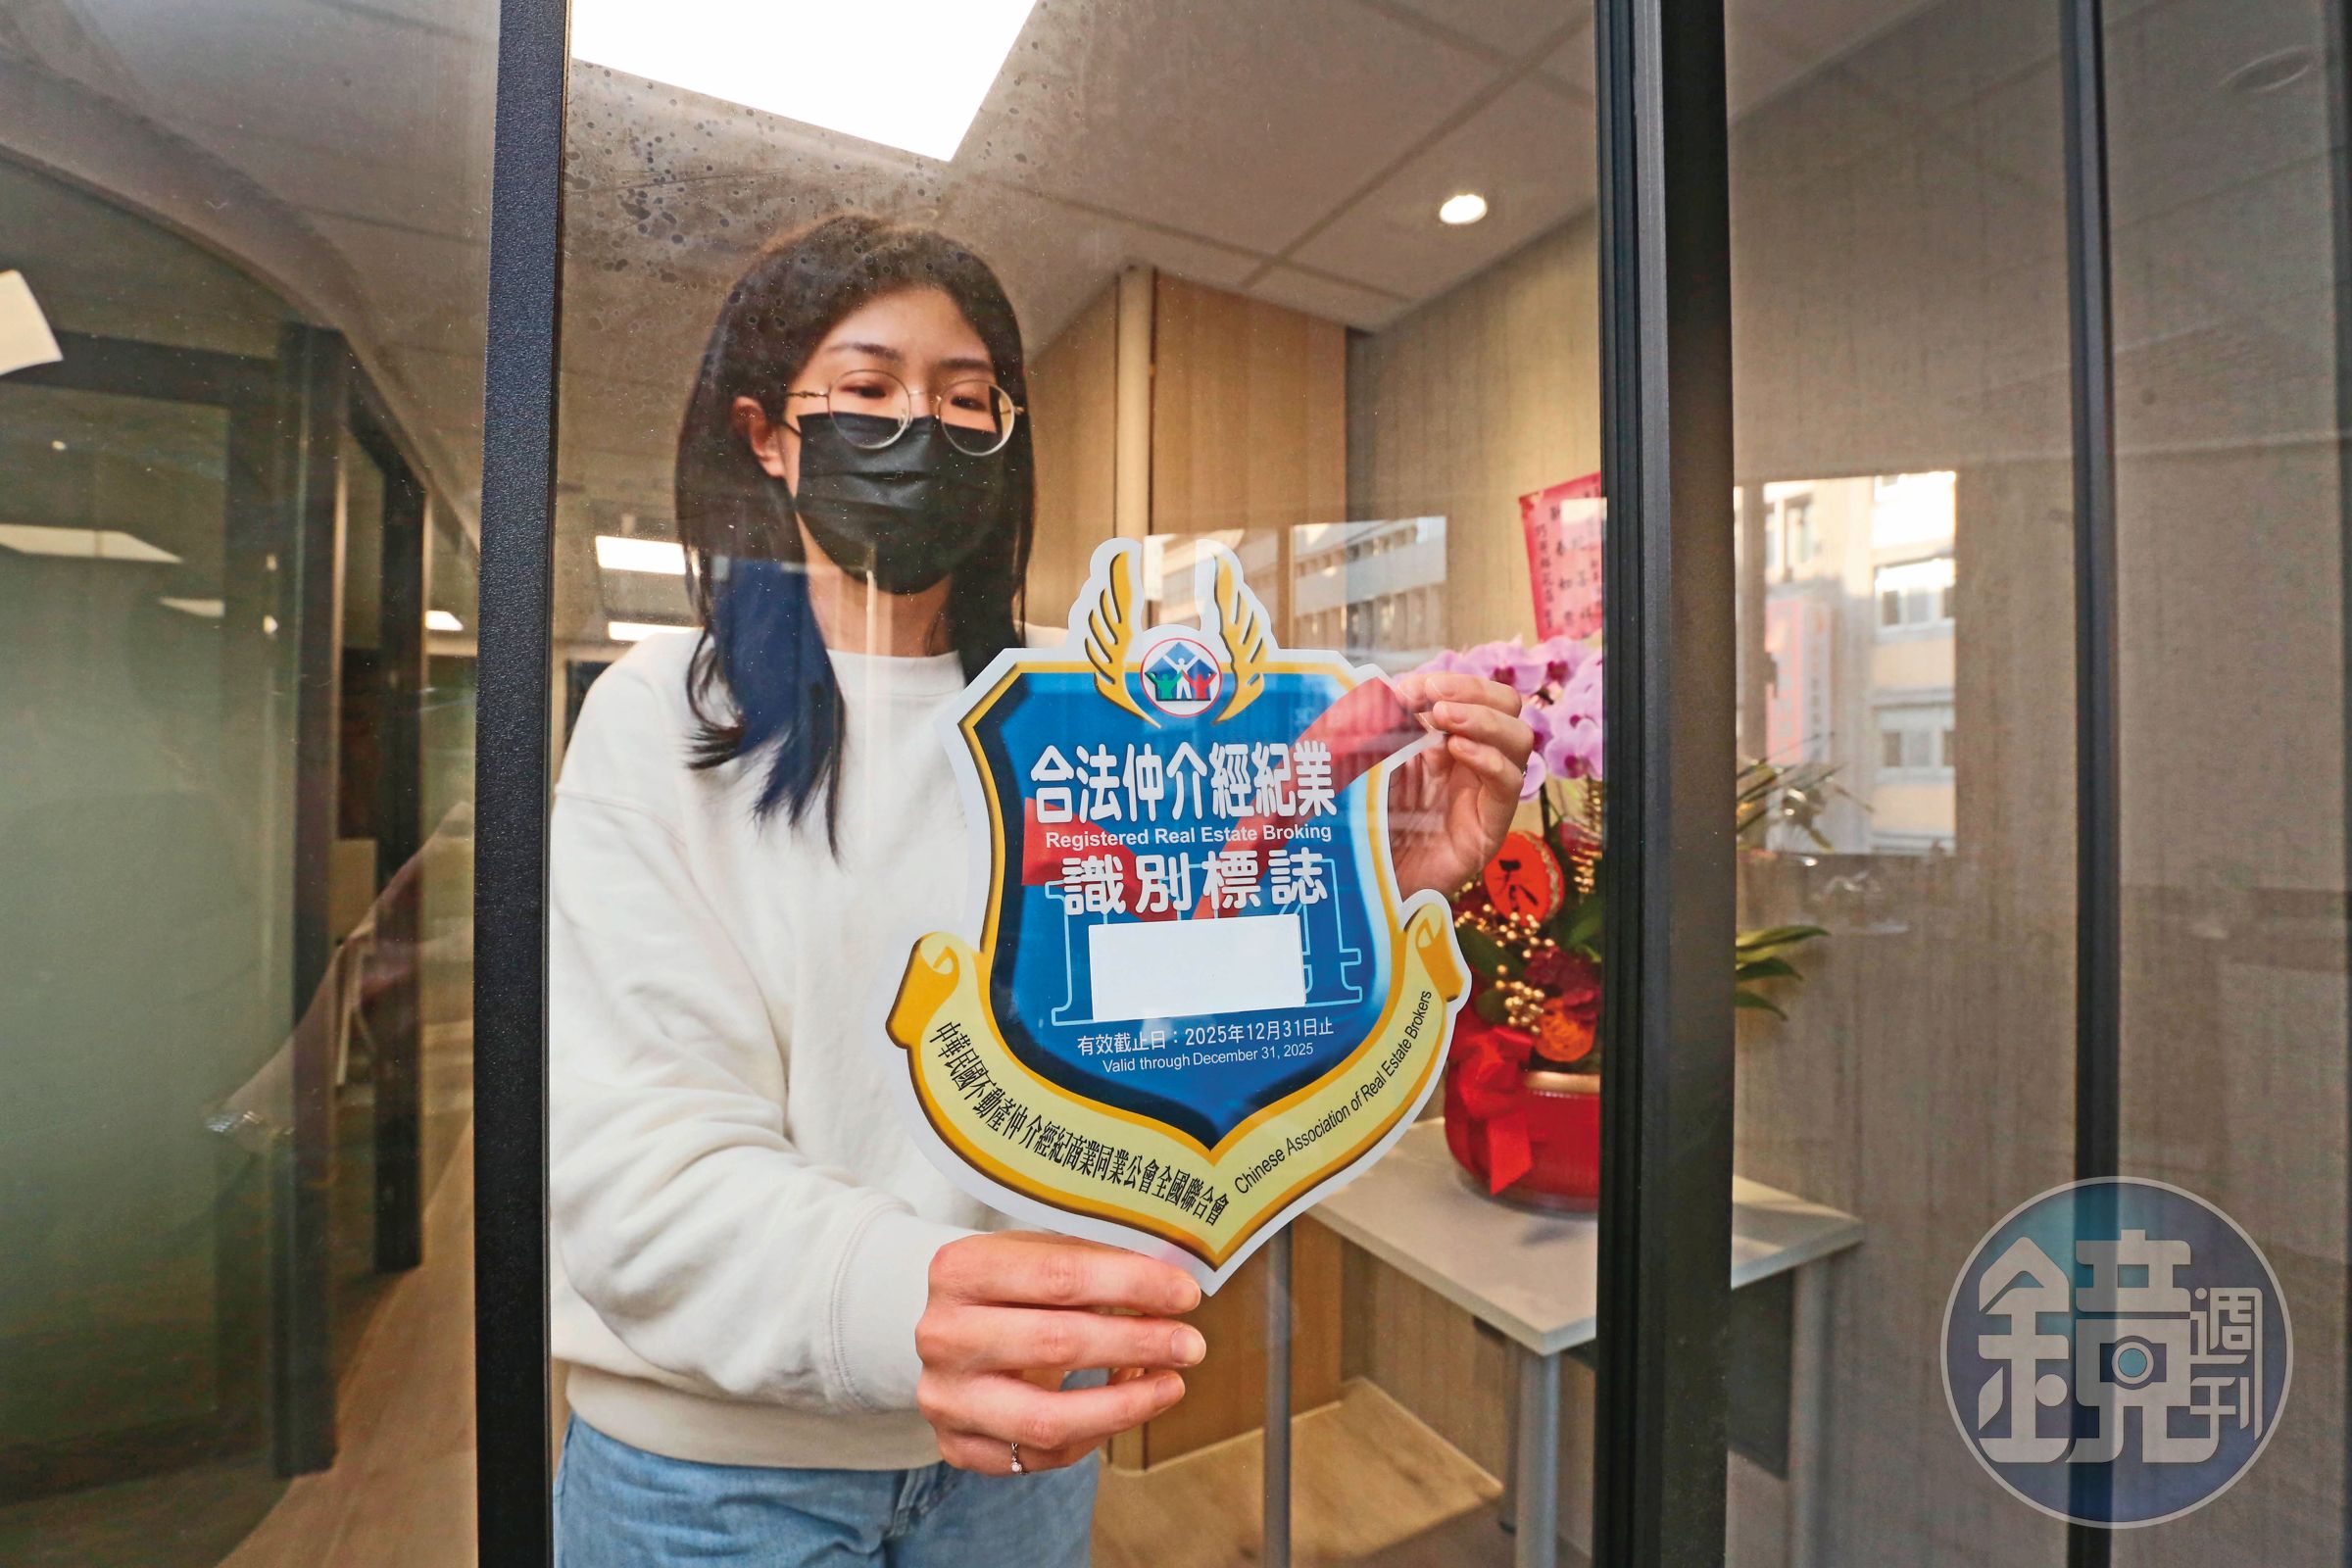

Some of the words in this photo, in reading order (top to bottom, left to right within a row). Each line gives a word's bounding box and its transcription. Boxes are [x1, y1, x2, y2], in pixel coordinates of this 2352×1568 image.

[1030, 741, 1338, 823] 合法仲介經紀業
[1046, 829, 1150, 852] Registered
[1154, 827, 1196, 846] Real
[1200, 825, 1258, 844] Estate
[1263, 823, 1332, 843] Broking
[1061, 847, 1328, 915] 識別標誌
[1102, 1058, 1135, 1073] Valid
[1140, 1054, 1191, 1071] through
[1193, 1048, 1257, 1065] December
[1261, 1046, 1280, 1060] 31,
[1284, 1042, 1314, 1057] 2025
[1234, 1148, 1286, 1194] Chinese
[1286, 1104, 1351, 1156] Association
[1351, 1092, 1363, 1111] of
[1360, 1071, 1387, 1102] Real
[1381, 1038, 1412, 1077] Estate
[1404, 990, 1432, 1040] Brokers
[929, 1021, 1229, 1226] 中華民國不動產仲介經紀商業同業公會全國聯合會
